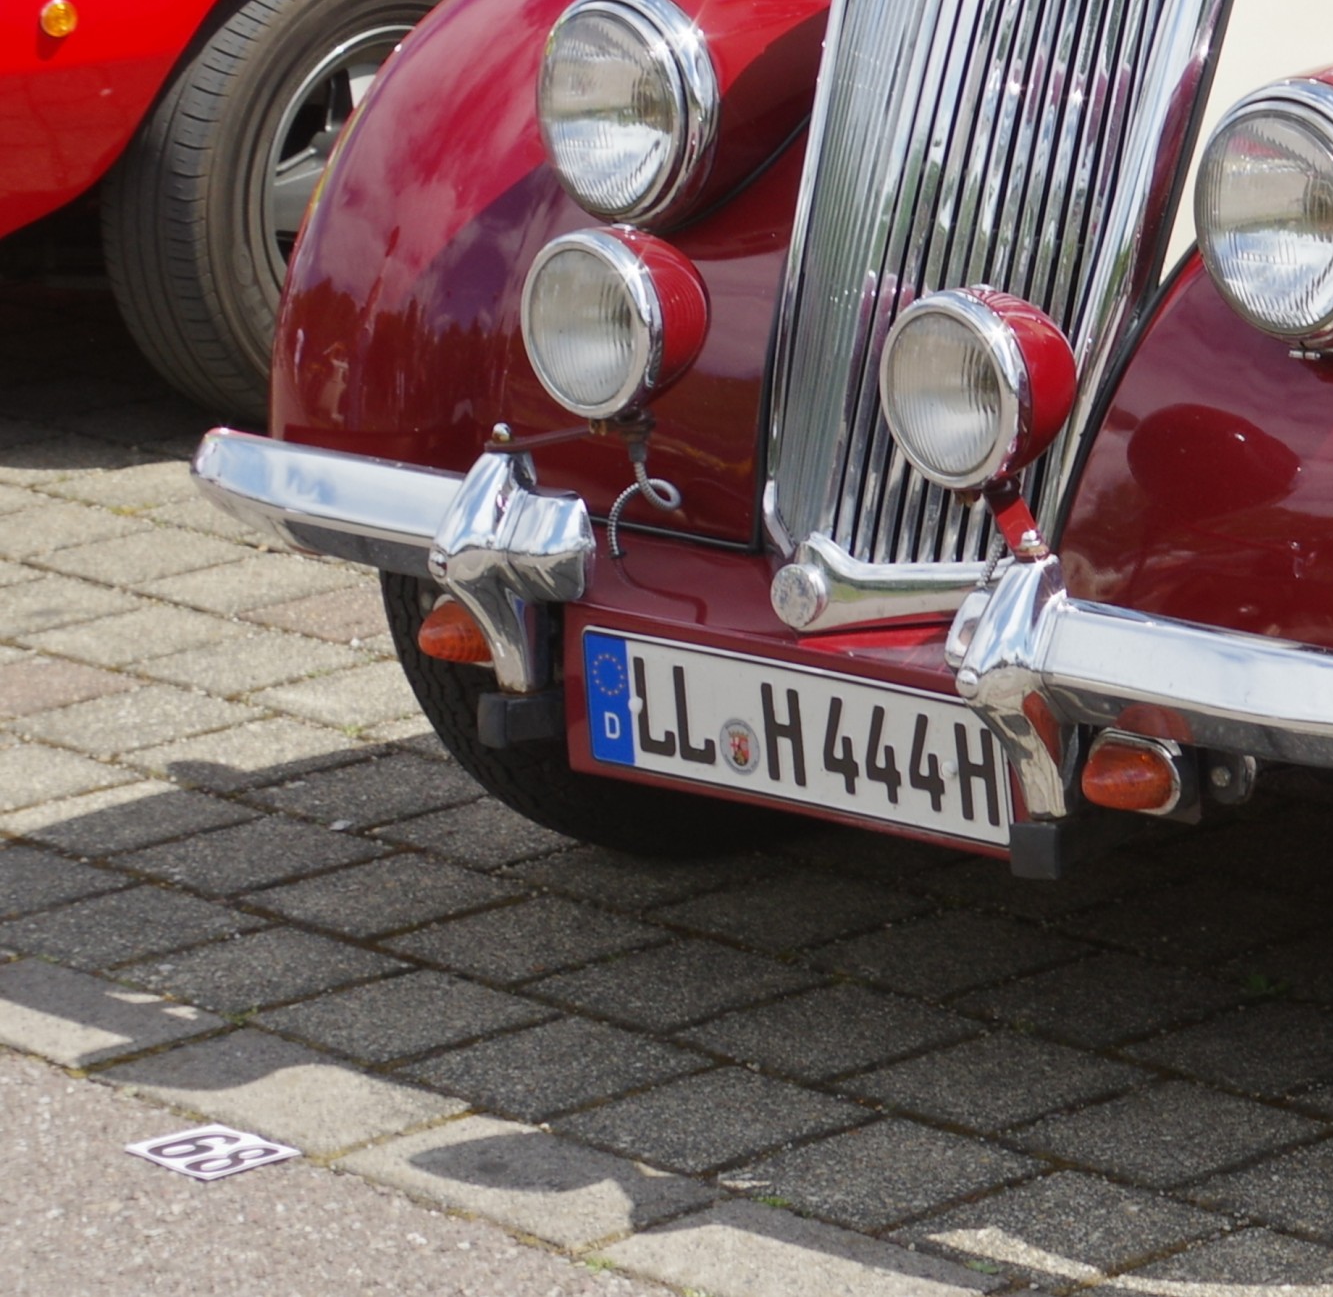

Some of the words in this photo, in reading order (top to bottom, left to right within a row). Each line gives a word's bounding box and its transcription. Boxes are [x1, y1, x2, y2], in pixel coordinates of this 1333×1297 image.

[604, 711, 621, 740] D
[632, 655, 716, 765] LL
[761, 682, 807, 787] H
[823, 697, 1001, 827] 444H
[147, 1134, 279, 1174] 68
